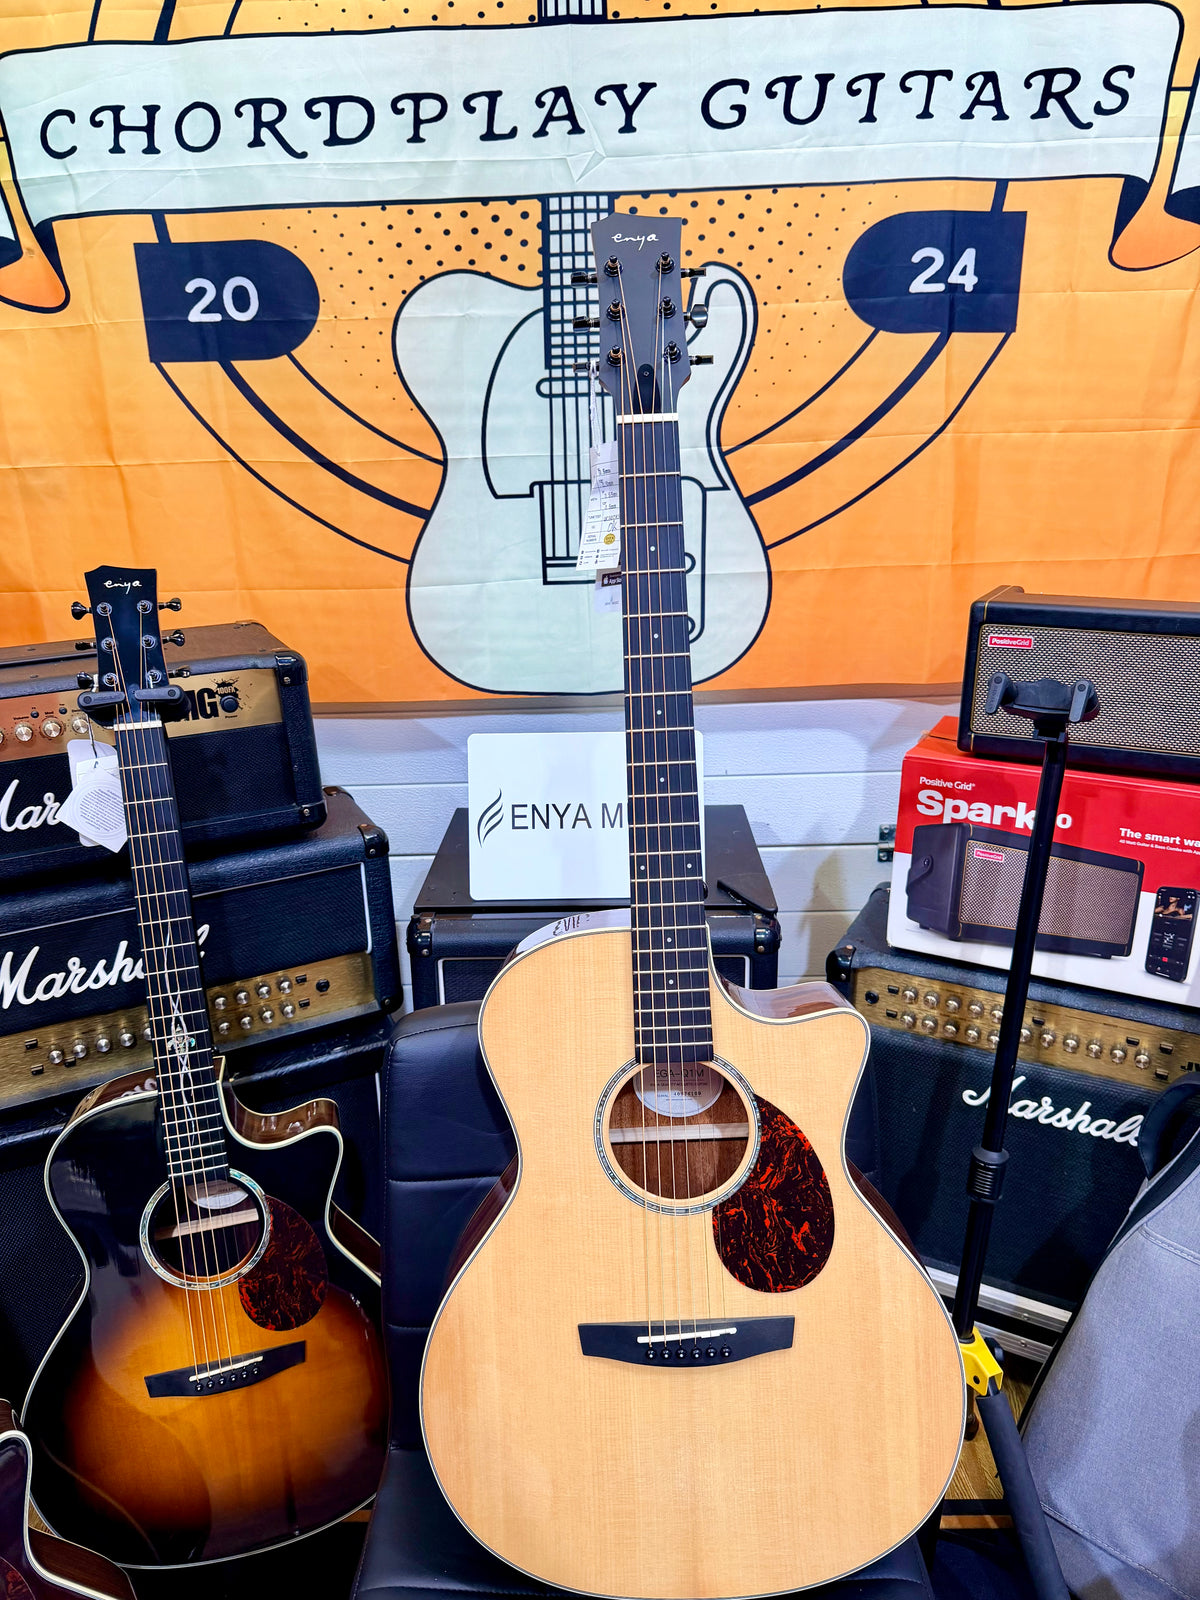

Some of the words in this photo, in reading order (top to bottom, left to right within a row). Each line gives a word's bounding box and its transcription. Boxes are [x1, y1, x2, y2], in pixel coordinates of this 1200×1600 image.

[40, 82, 657, 159] CHORDPLAY
[700, 64, 1135, 130] GUITARS
[611, 233, 659, 251] enya
[908, 247, 978, 294] 24
[184, 276, 259, 323] 20
[103, 579, 143, 594] enya
[920, 777, 953, 788] Positive
[511, 803, 592, 829] ENYA
[916, 789, 1036, 830] Spark
[1119, 827, 1142, 839] The
[1144, 833, 1181, 845] smart
